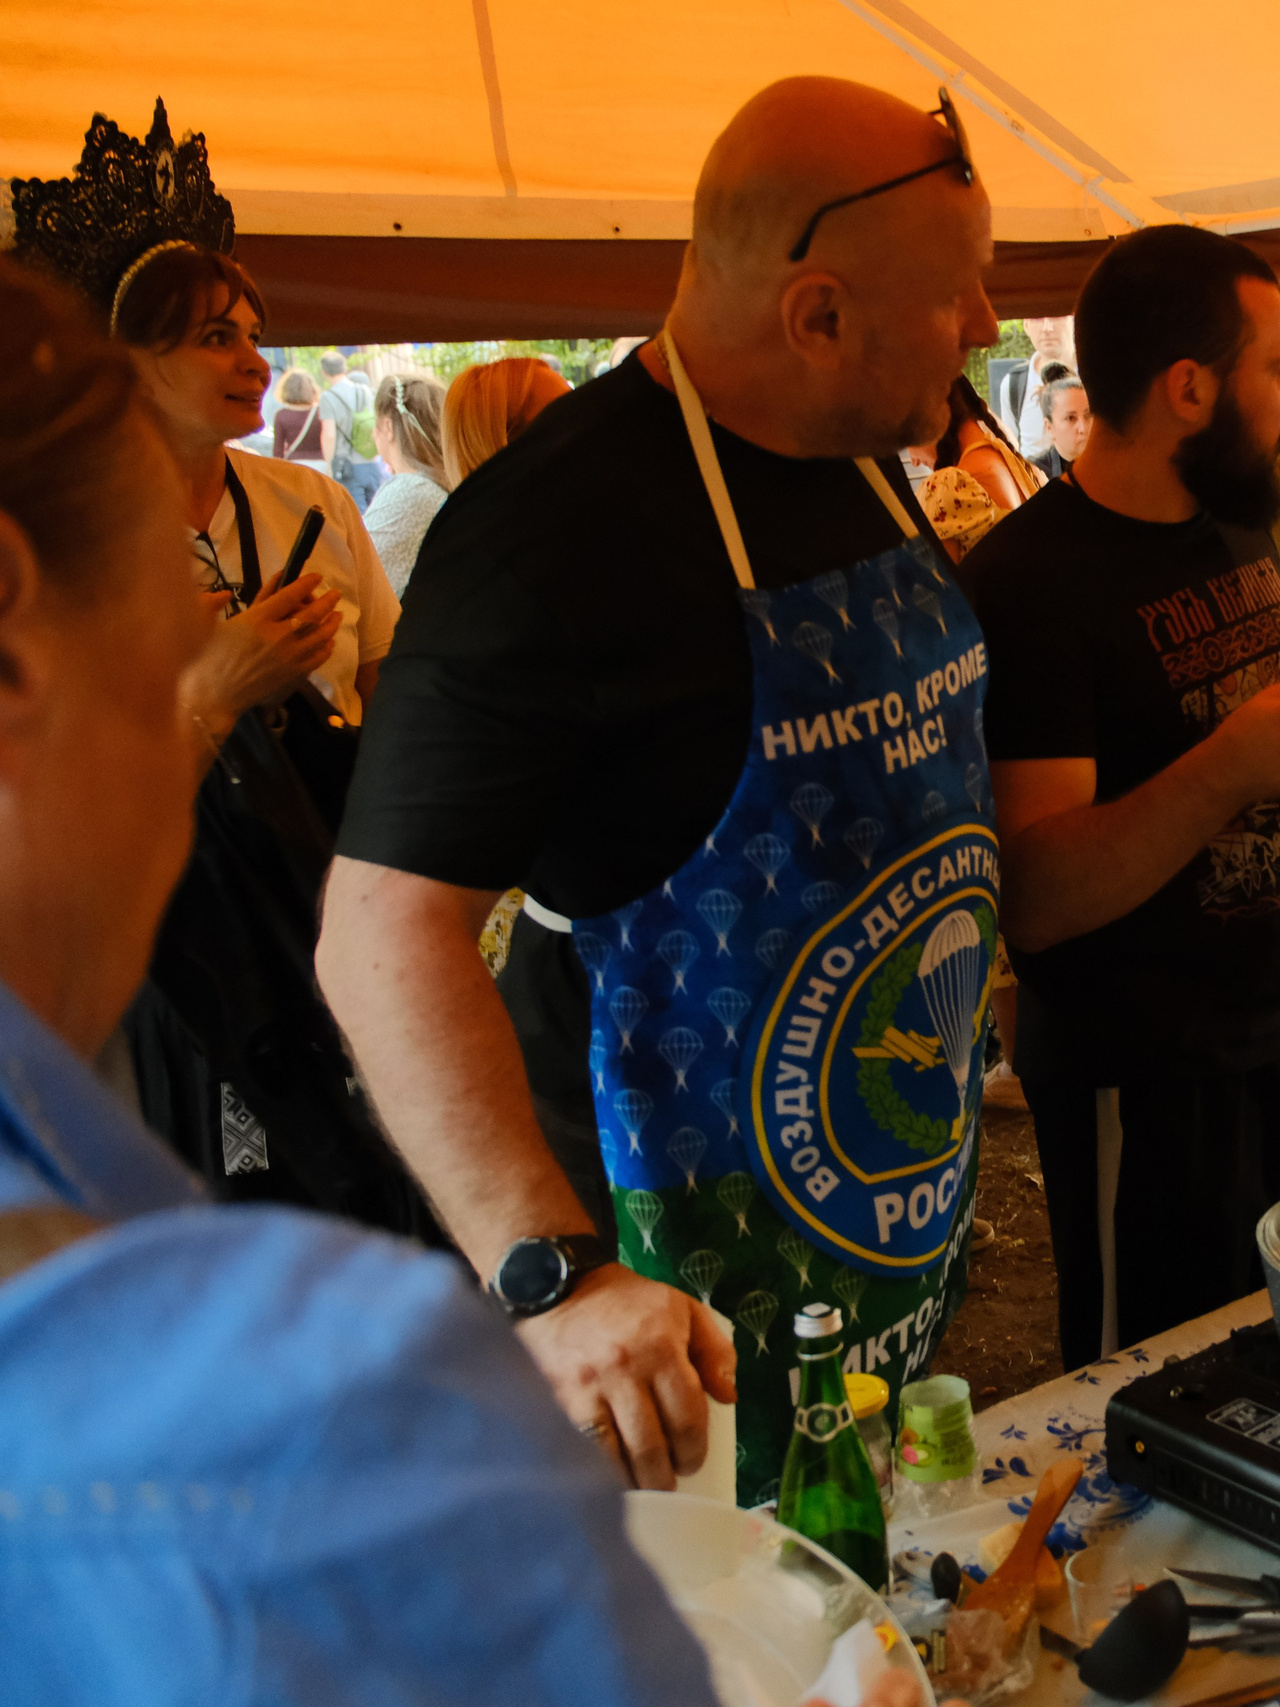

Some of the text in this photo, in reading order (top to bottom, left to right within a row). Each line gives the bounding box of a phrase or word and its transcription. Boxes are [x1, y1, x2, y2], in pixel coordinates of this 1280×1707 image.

[761, 641, 988, 761] НИКТО, КРОМЕ
[882, 714, 948, 775] НАС!
